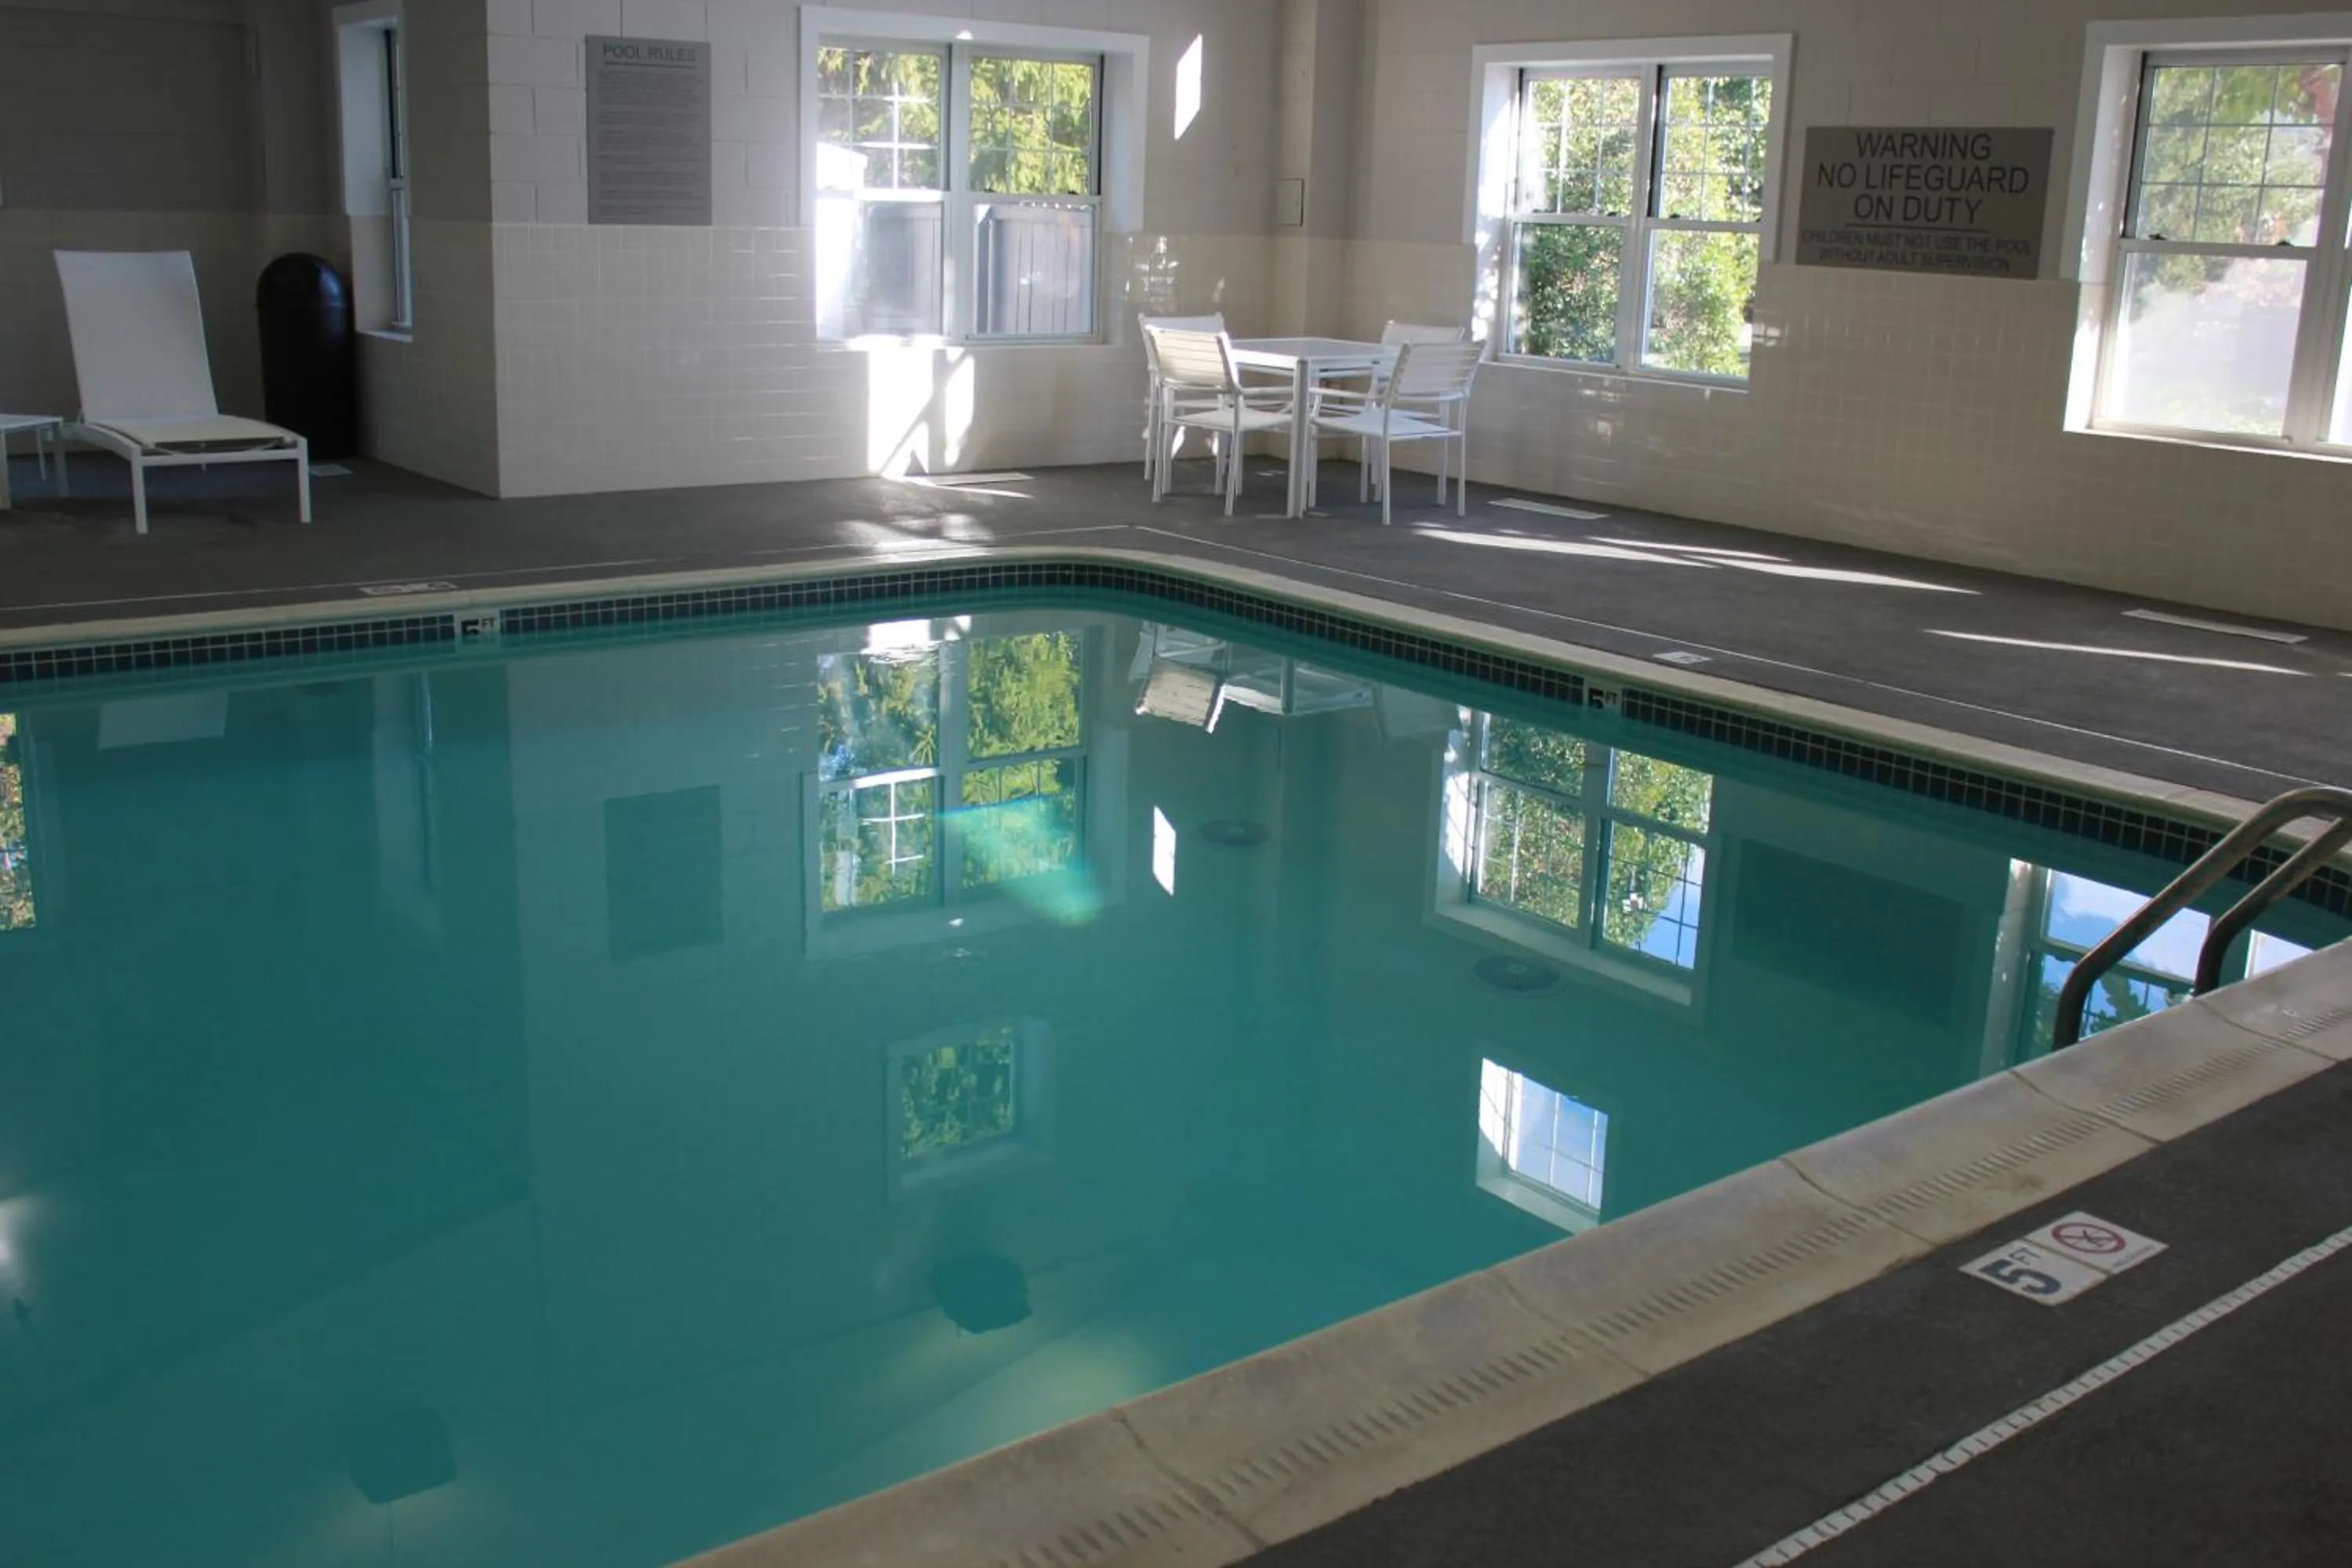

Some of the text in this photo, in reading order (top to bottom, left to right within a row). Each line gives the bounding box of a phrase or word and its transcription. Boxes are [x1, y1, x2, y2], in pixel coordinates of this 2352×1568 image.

[602, 43, 697, 62] POOL RULES
[1857, 132, 1992, 161] WARNING
[1817, 163, 2030, 194] NO LIFEGUARD
[1854, 194, 1984, 224] ON DUTY
[1936, 235, 1964, 250] USE
[1967, 237, 1993, 252] THE
[1996, 238, 2033, 255] POOL
[1978, 1247, 2062, 1295] 5 FT
